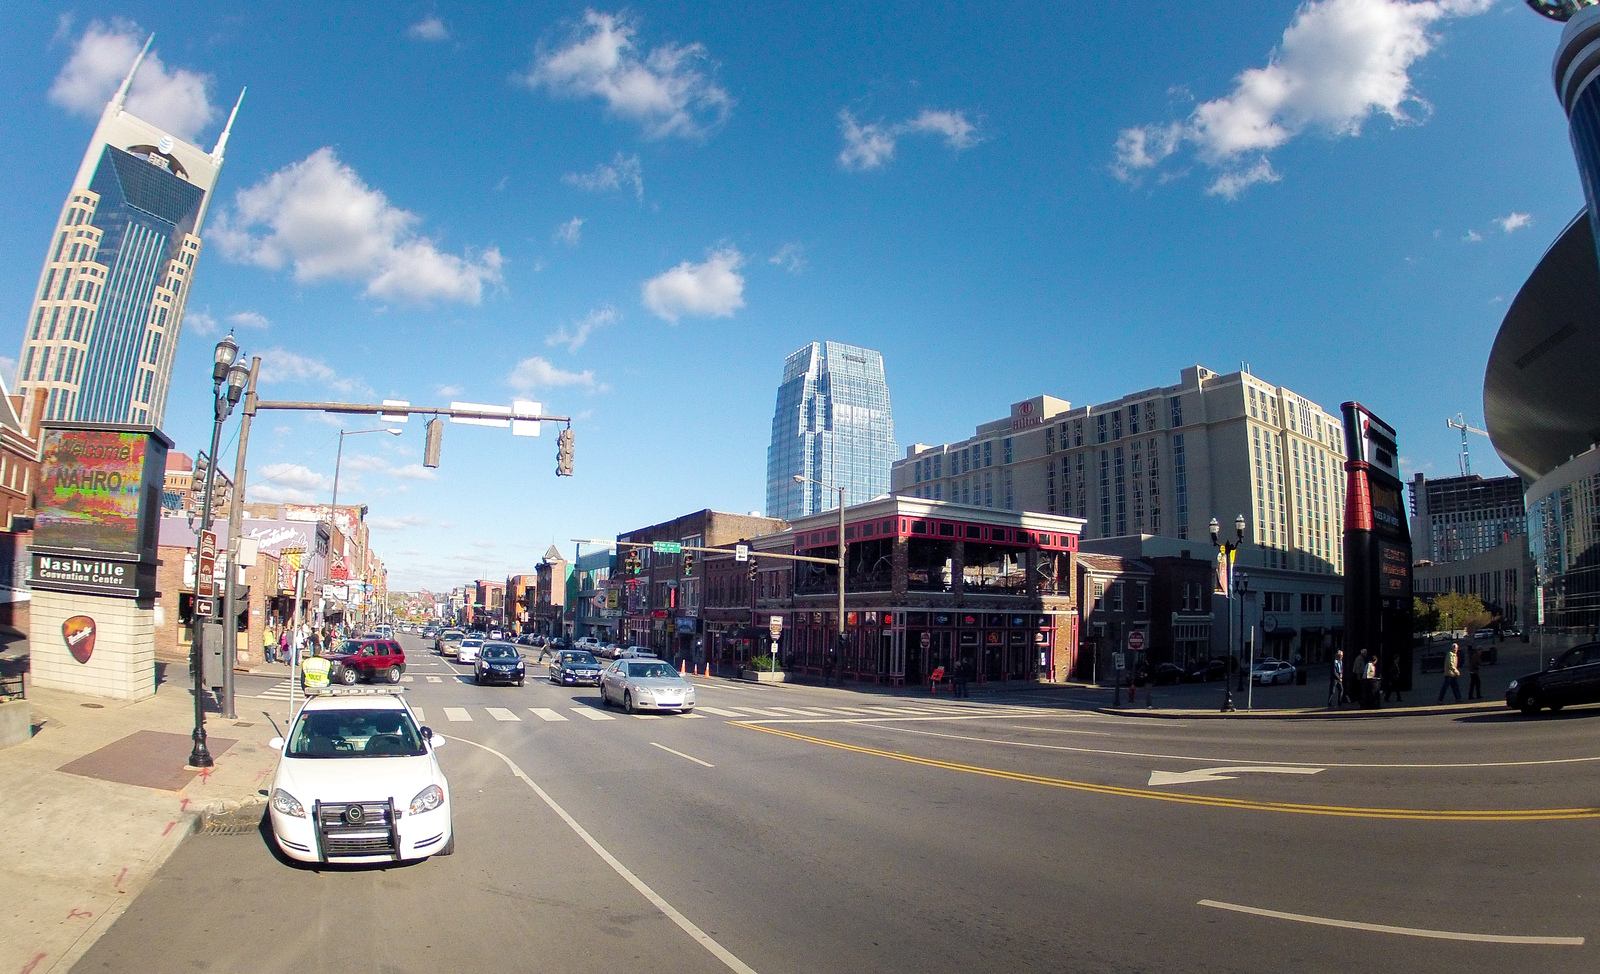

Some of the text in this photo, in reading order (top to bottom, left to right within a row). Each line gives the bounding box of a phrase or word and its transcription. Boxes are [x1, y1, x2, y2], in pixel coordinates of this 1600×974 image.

[1013, 416, 1043, 430] Hilton
[57, 437, 130, 460] Welcome
[56, 467, 122, 492] NAHRO
[40, 557, 125, 576] Nashville
[40, 570, 124, 585] Convention Center
